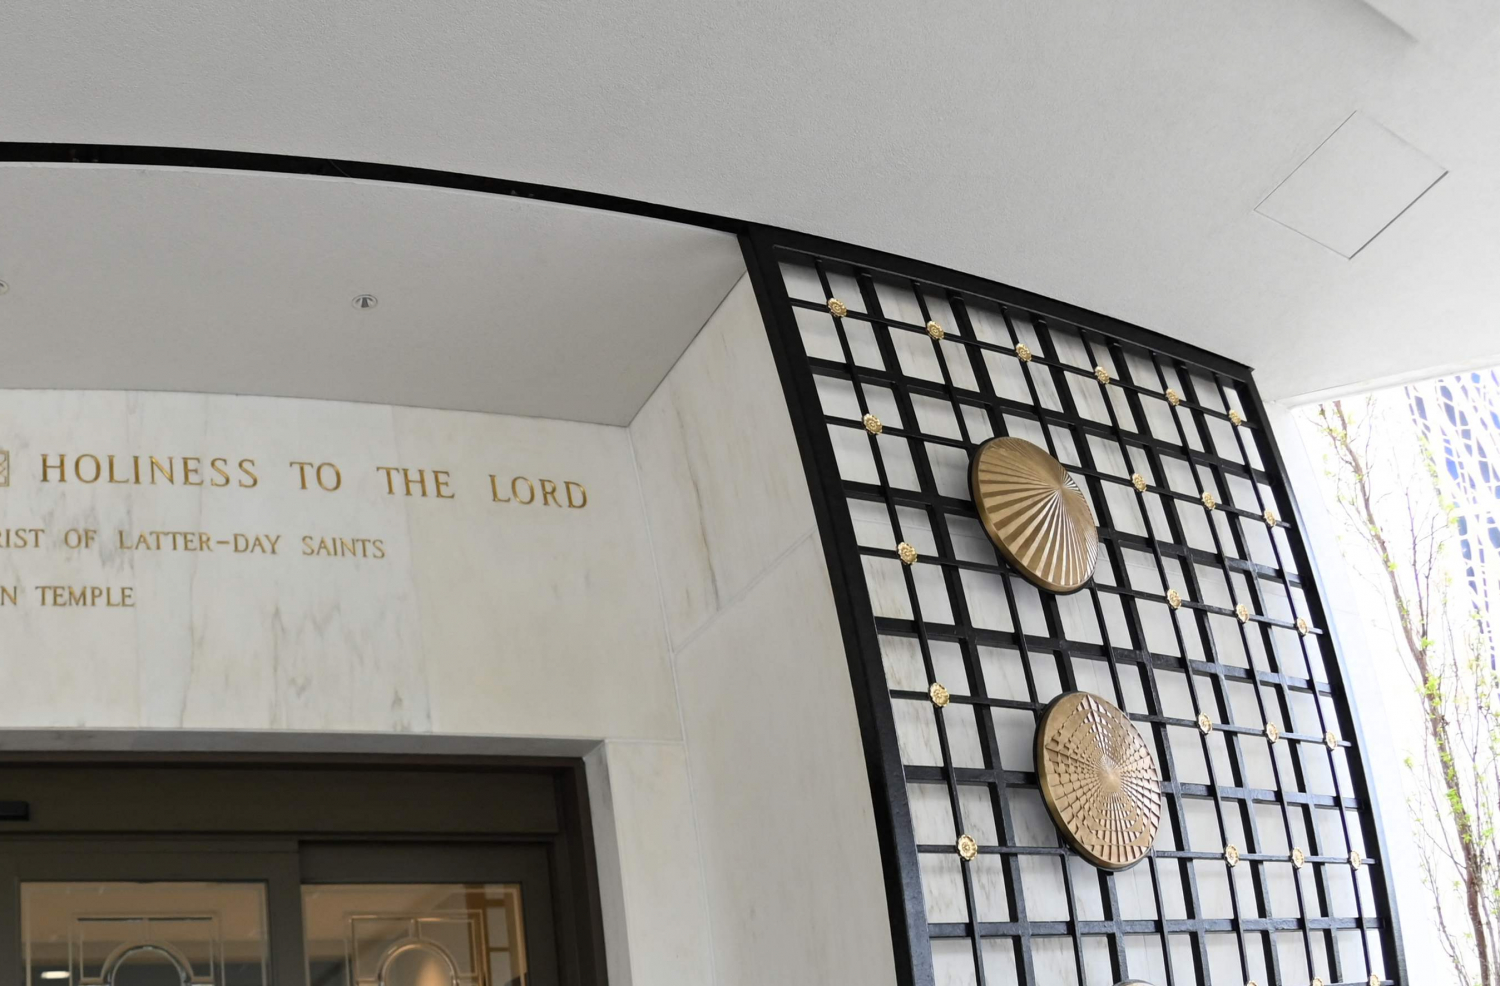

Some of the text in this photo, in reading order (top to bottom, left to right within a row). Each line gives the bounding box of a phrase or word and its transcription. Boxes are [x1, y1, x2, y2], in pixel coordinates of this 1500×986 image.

[40, 453, 260, 489] HOLINESS
[289, 461, 343, 492] TO
[376, 466, 455, 500] THE
[488, 474, 589, 510] LORD
[64, 528, 97, 550] OF
[118, 530, 281, 556] LATTER-DAY
[302, 535, 386, 560] SAINTS
[35, 585, 136, 608] TEMPLE
